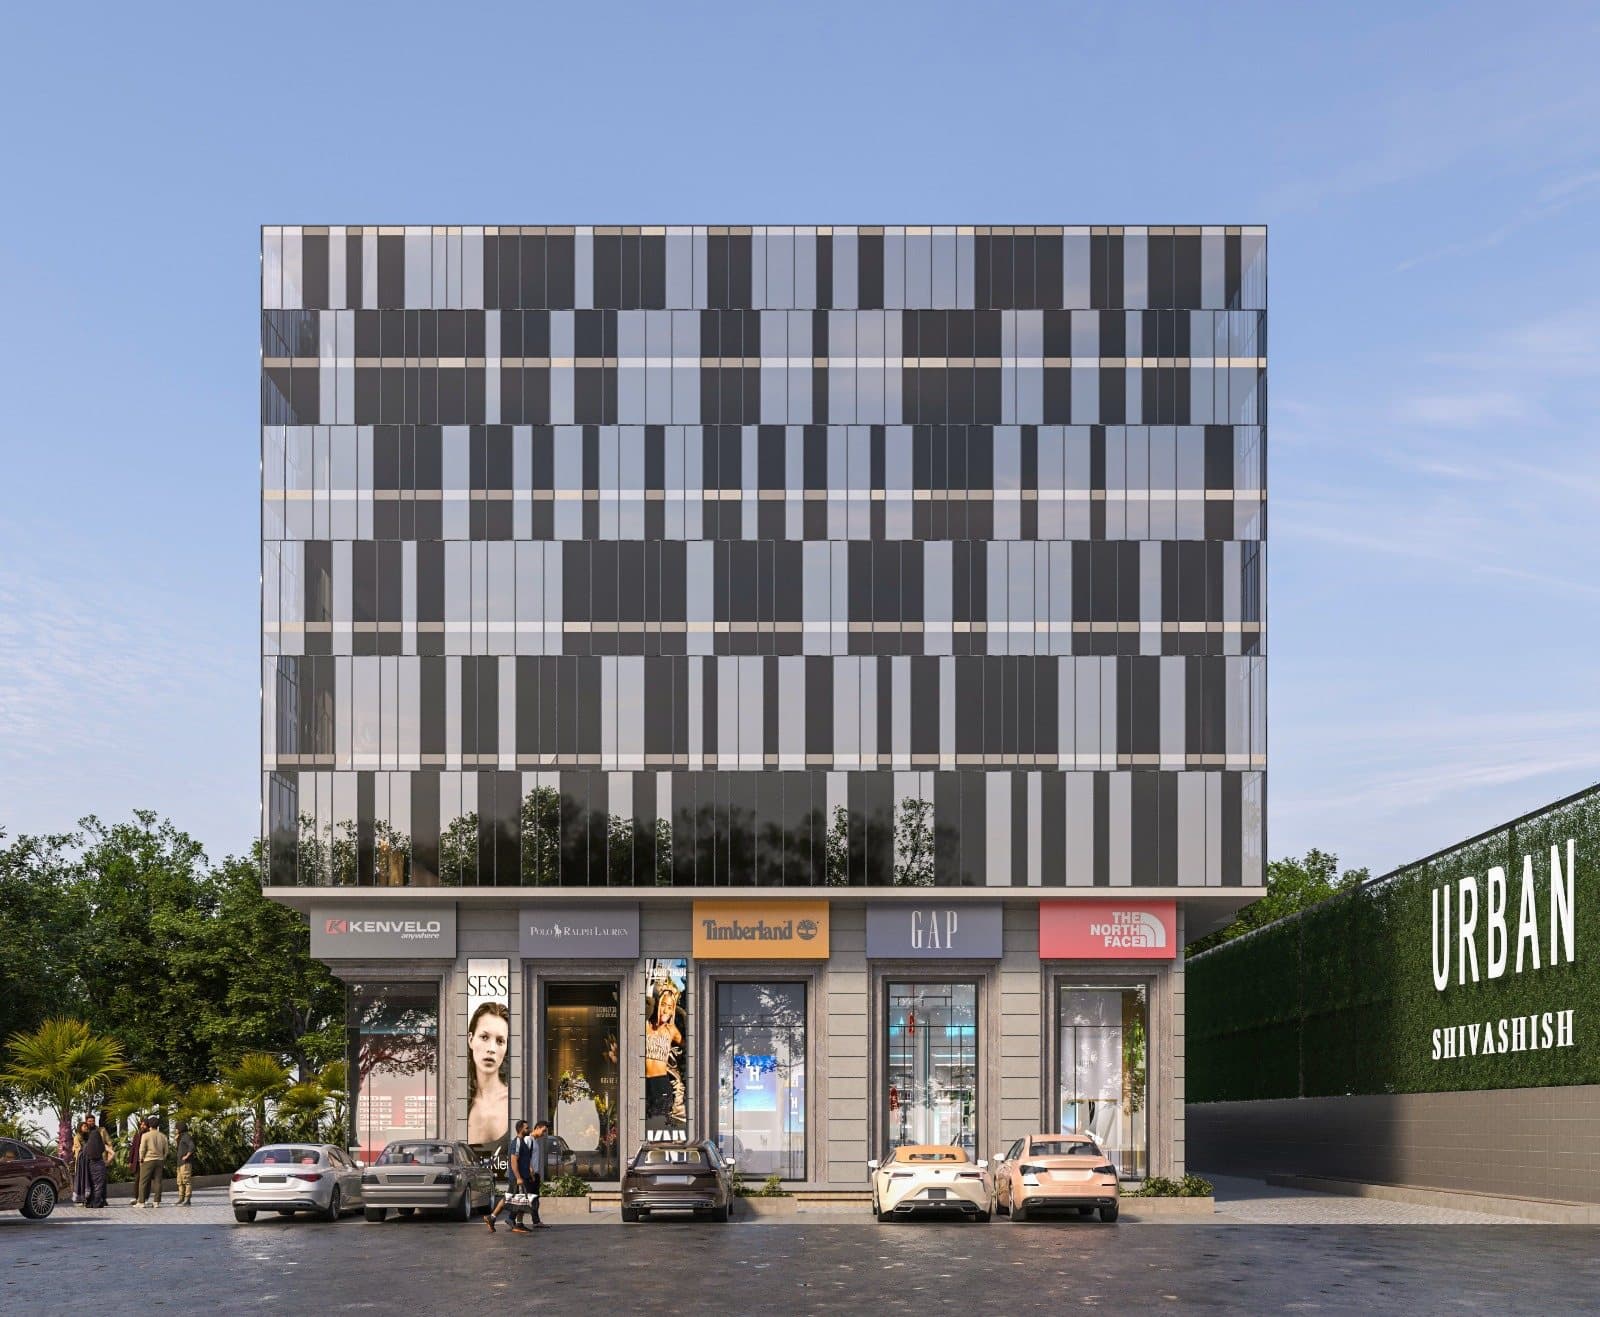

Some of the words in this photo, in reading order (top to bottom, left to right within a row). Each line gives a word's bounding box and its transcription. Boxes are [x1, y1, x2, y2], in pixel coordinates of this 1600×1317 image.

[1112, 911, 1141, 924] THE
[1432, 839, 1575, 992] URBAN
[349, 921, 441, 933] KENVELO
[702, 919, 793, 940] Timberland
[911, 910, 958, 949] GAP
[1090, 924, 1140, 935] NORTH
[400, 932, 440, 941] anywhere
[1104, 936, 1141, 947] FACE
[467, 975, 508, 992] SESS
[1432, 1009, 1575, 1060] SHIVASHISH
